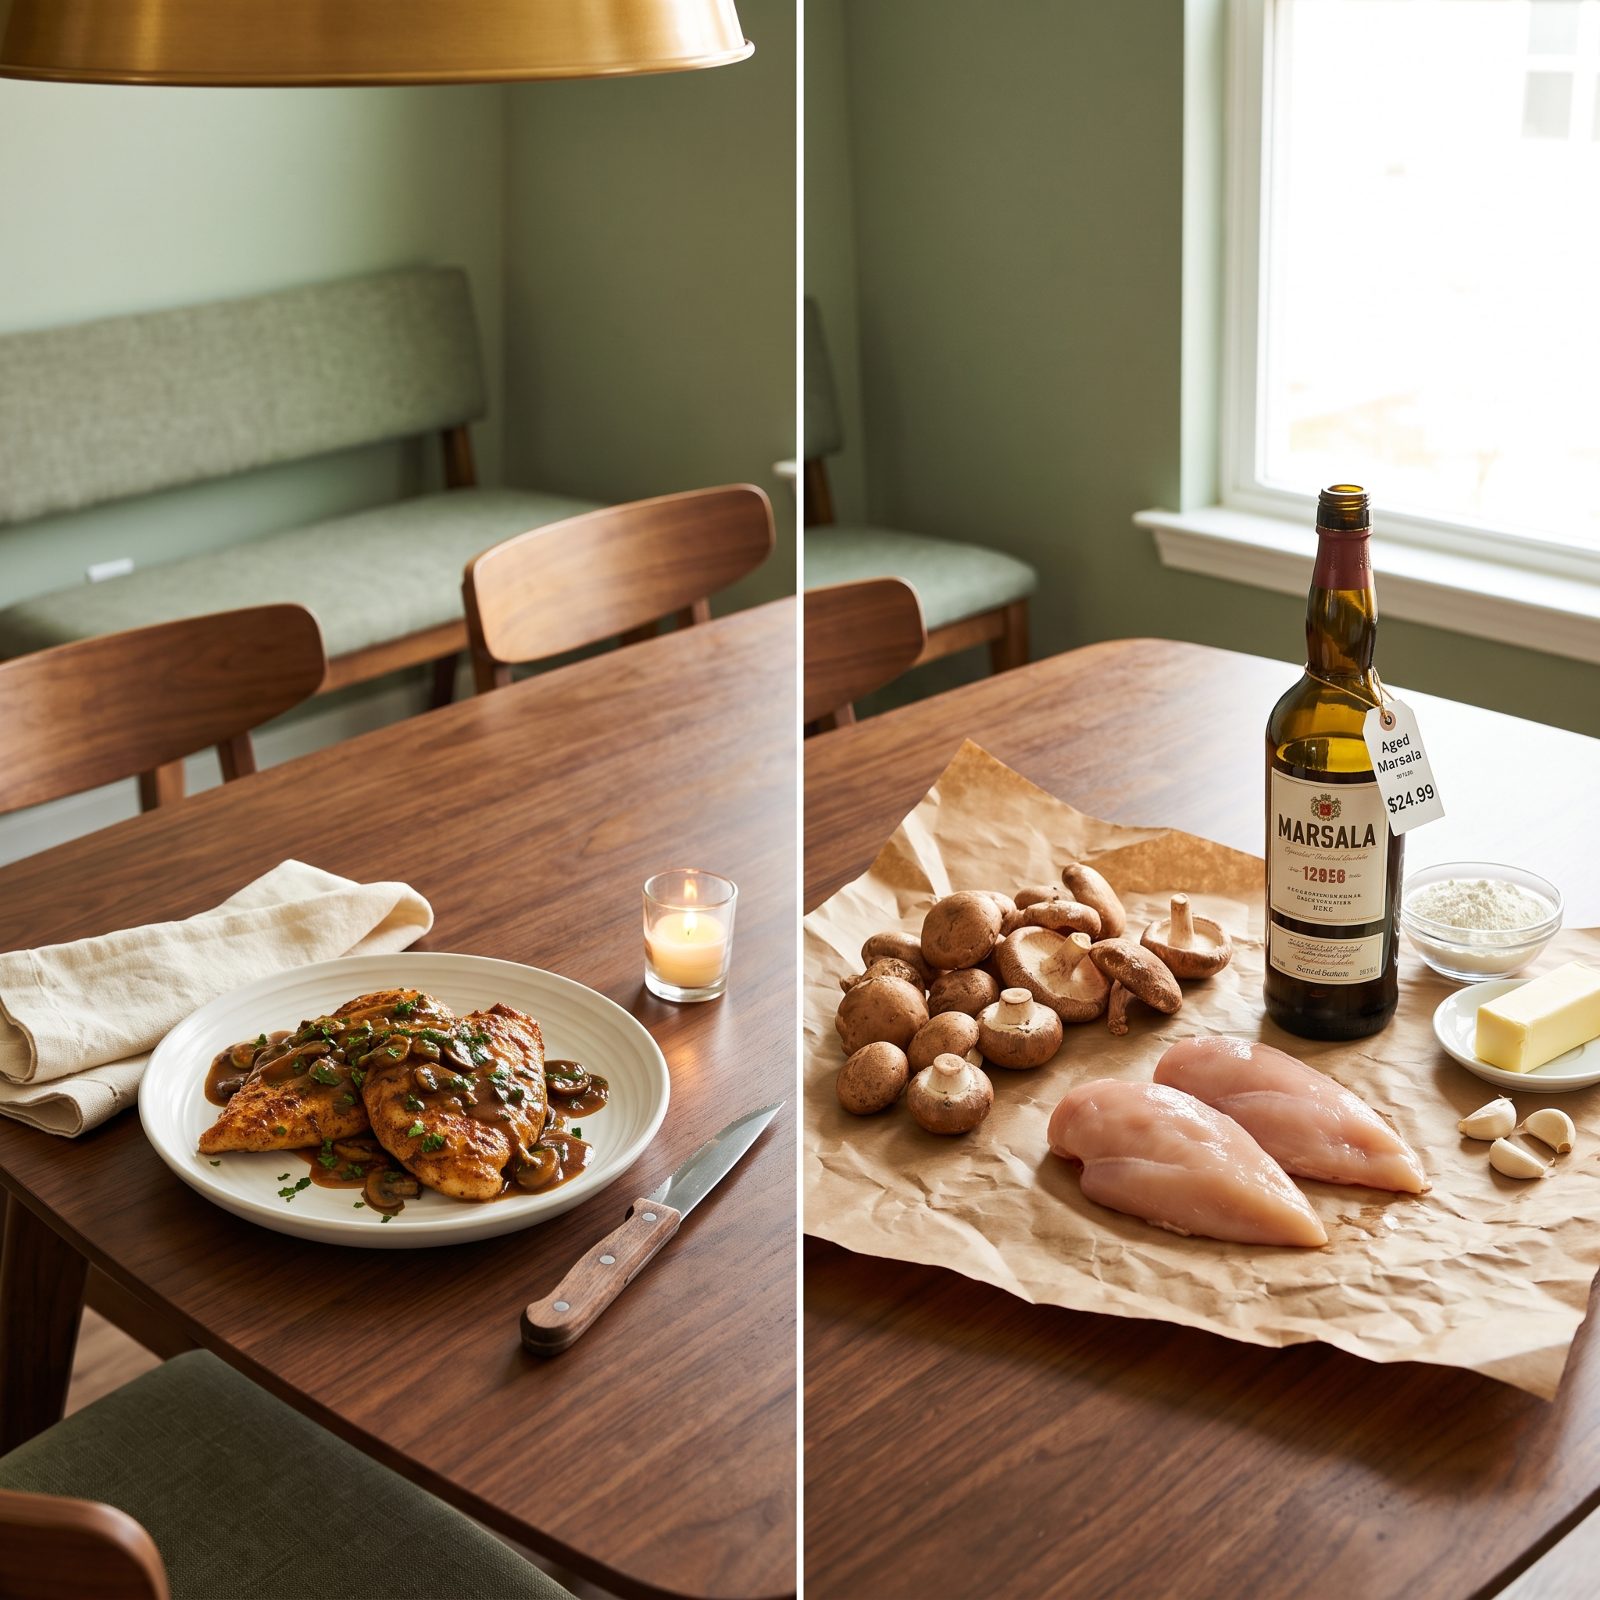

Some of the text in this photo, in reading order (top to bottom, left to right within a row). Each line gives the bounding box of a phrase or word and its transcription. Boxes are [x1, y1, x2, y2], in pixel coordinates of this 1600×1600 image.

[1381, 733, 1410, 753] Aged
[1377, 750, 1422, 773] Marsala
[1387, 784, 1434, 814] $24.99
[1278, 813, 1376, 849] MARSALA
